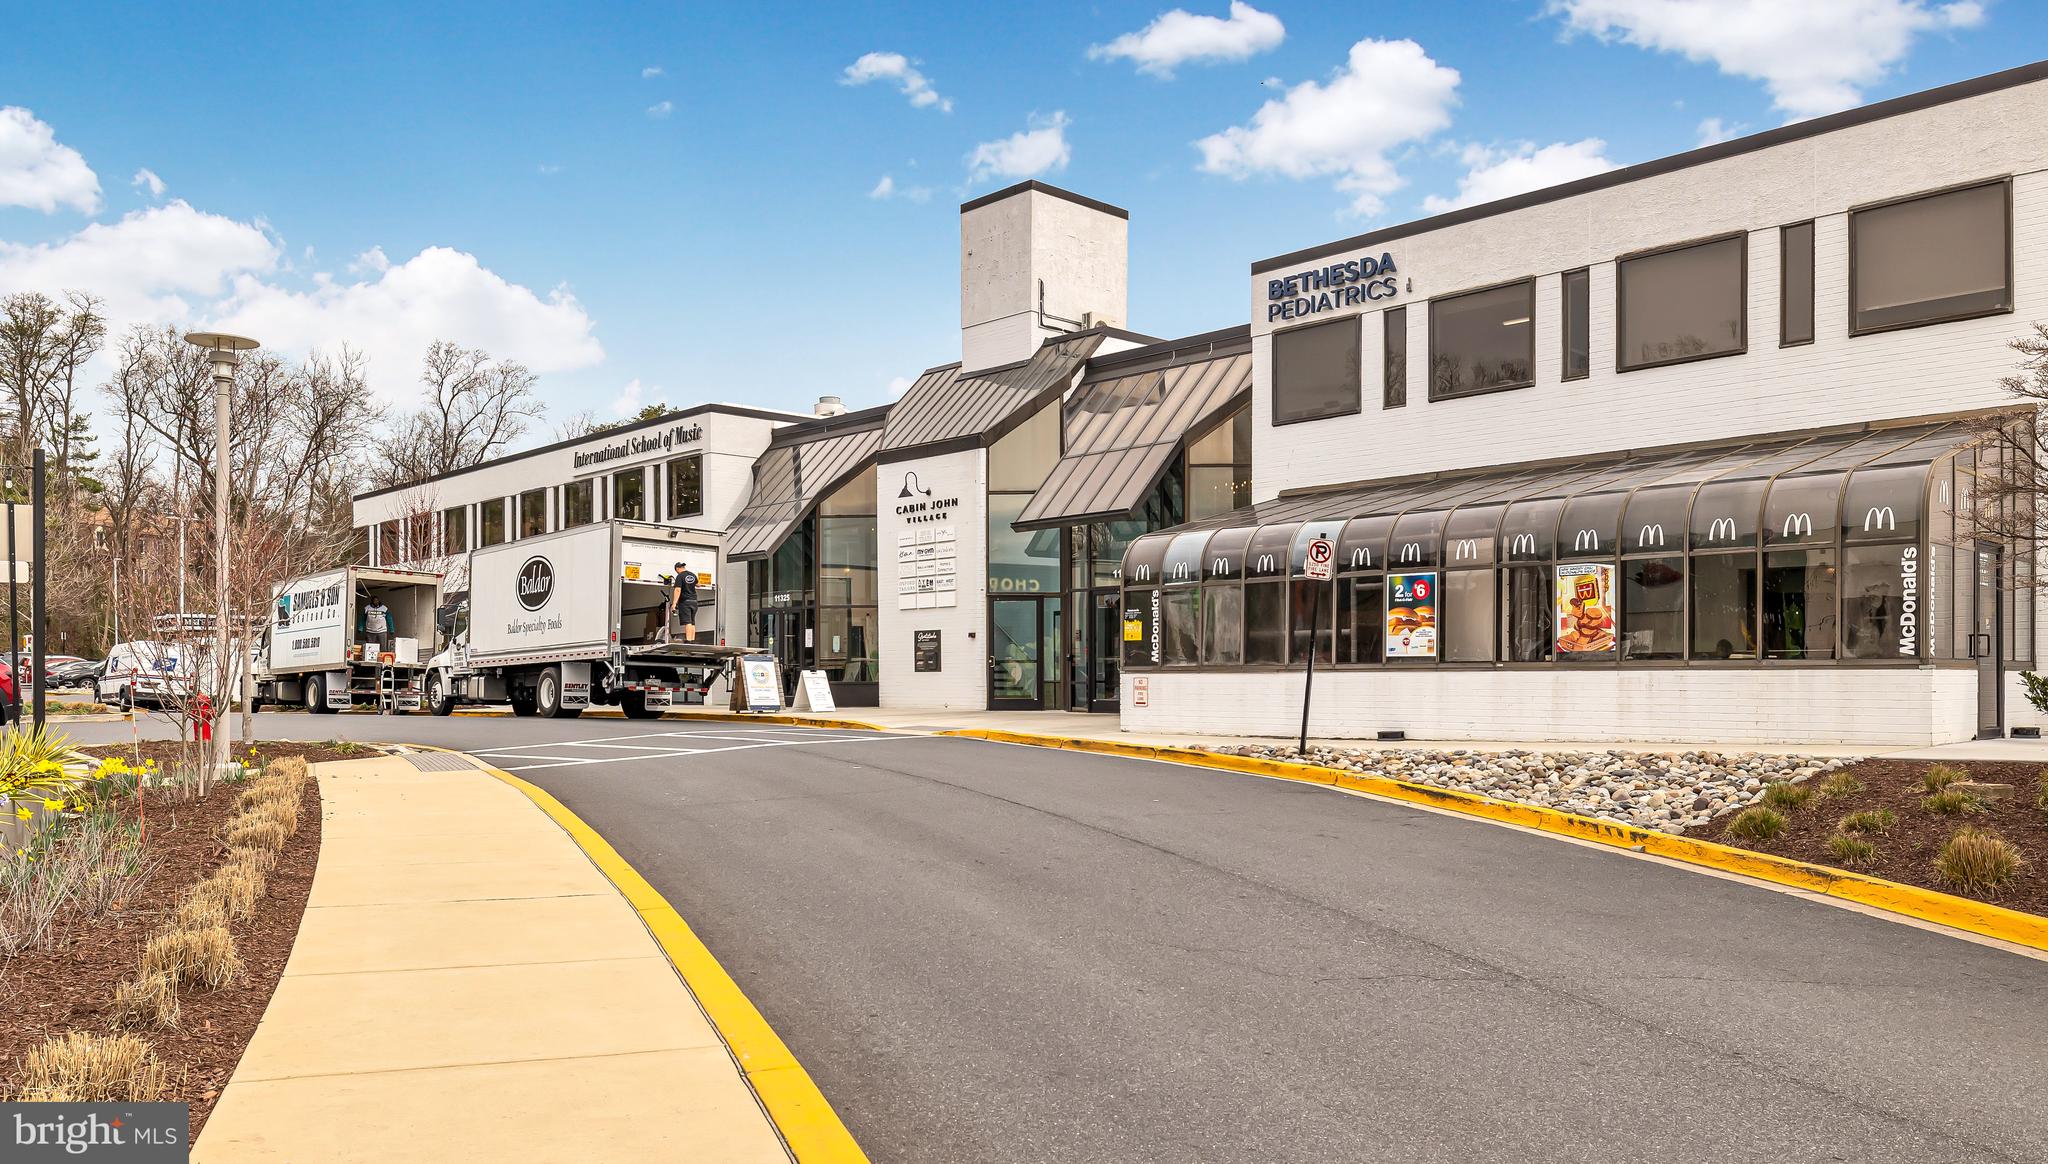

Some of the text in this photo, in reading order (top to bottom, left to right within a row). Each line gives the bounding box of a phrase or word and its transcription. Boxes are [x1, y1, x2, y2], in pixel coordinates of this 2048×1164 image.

[1268, 252, 1397, 300] BETHESDA
[1268, 277, 1398, 322] PEDIATRICS
[573, 423, 703, 469] International School of Music
[896, 497, 958, 515] CABIN JOHN
[906, 512, 947, 524] VILLAGE
[520, 563, 551, 596] Baldor
[1394, 584, 1405, 598] 2
[292, 589, 320, 612] SAMUELS
[326, 584, 340, 606] SON
[774, 593, 791, 602] 11325
[1899, 546, 1918, 656] McDonald's
[507, 613, 562, 637] Baldor Specialty Foods
[1151, 589, 1160, 663] McDonald's
